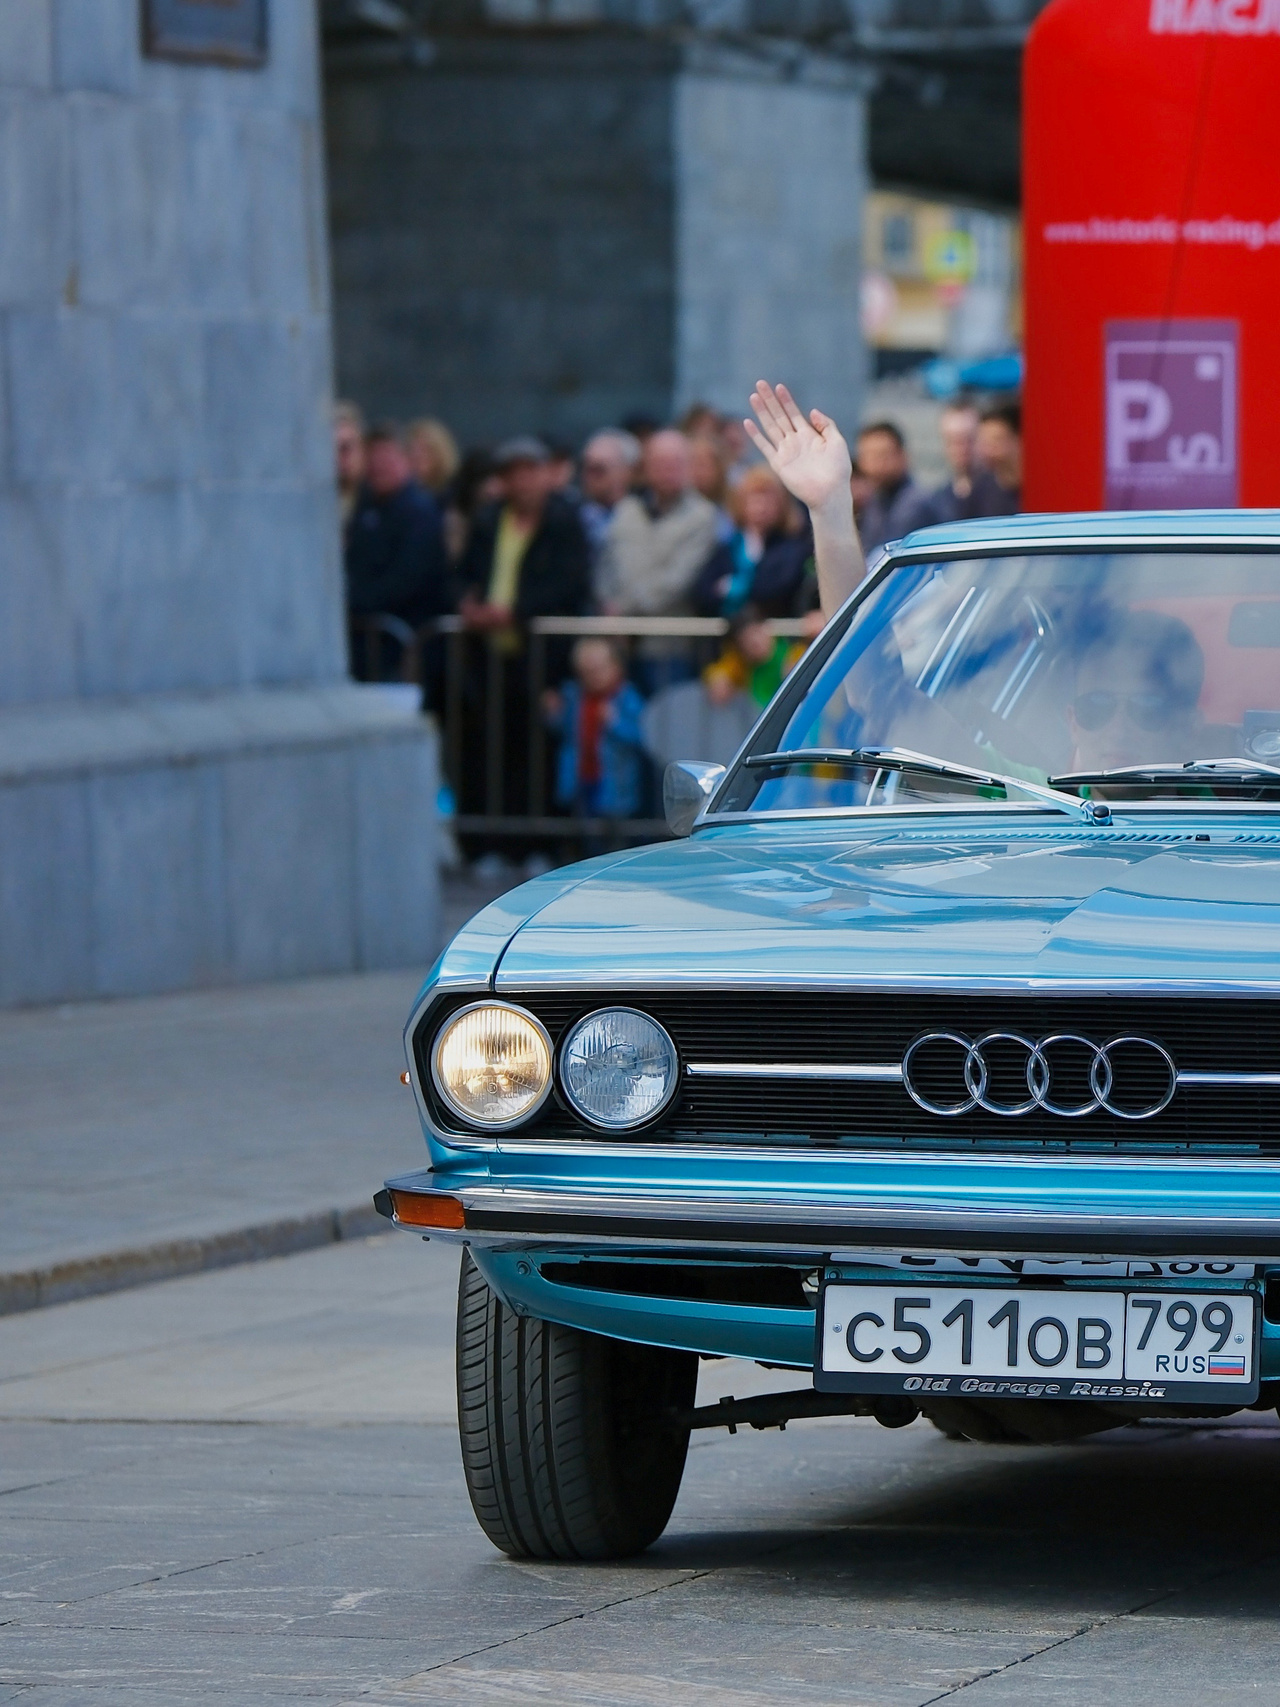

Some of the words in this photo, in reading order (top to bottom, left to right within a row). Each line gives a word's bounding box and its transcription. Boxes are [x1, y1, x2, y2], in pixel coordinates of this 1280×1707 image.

[1131, 1300, 1233, 1352] 799
[1155, 1354, 1206, 1374] RUS
[902, 1376, 952, 1392] Old
[959, 1379, 1062, 1397] Garage
[1069, 1381, 1167, 1398] Russia
